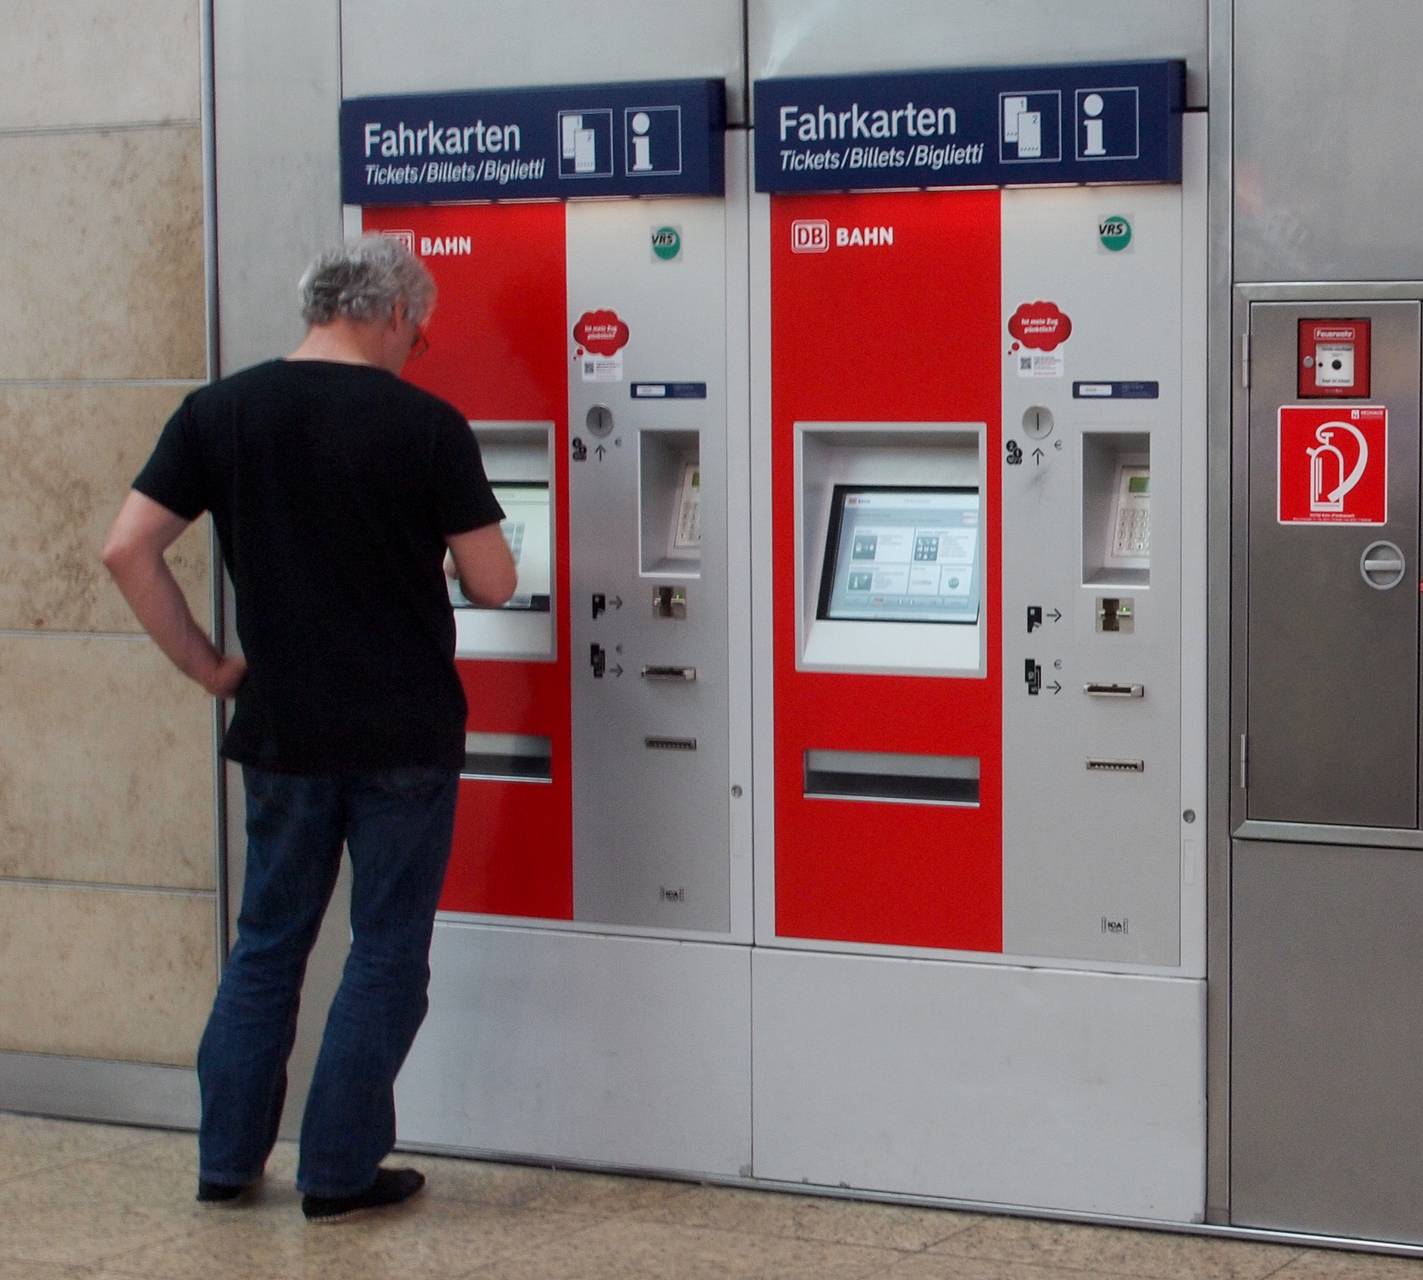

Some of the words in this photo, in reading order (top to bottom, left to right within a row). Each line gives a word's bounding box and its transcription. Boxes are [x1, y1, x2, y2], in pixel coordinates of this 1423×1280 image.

[779, 102, 957, 142] Fahrkarten
[364, 119, 521, 158] Fahrkarten
[651, 233, 674, 245] VRS
[795, 223, 826, 248] DB
[836, 227, 894, 246] BAHN
[1099, 223, 1124, 236] VRS
[420, 236, 471, 256] BAHN
